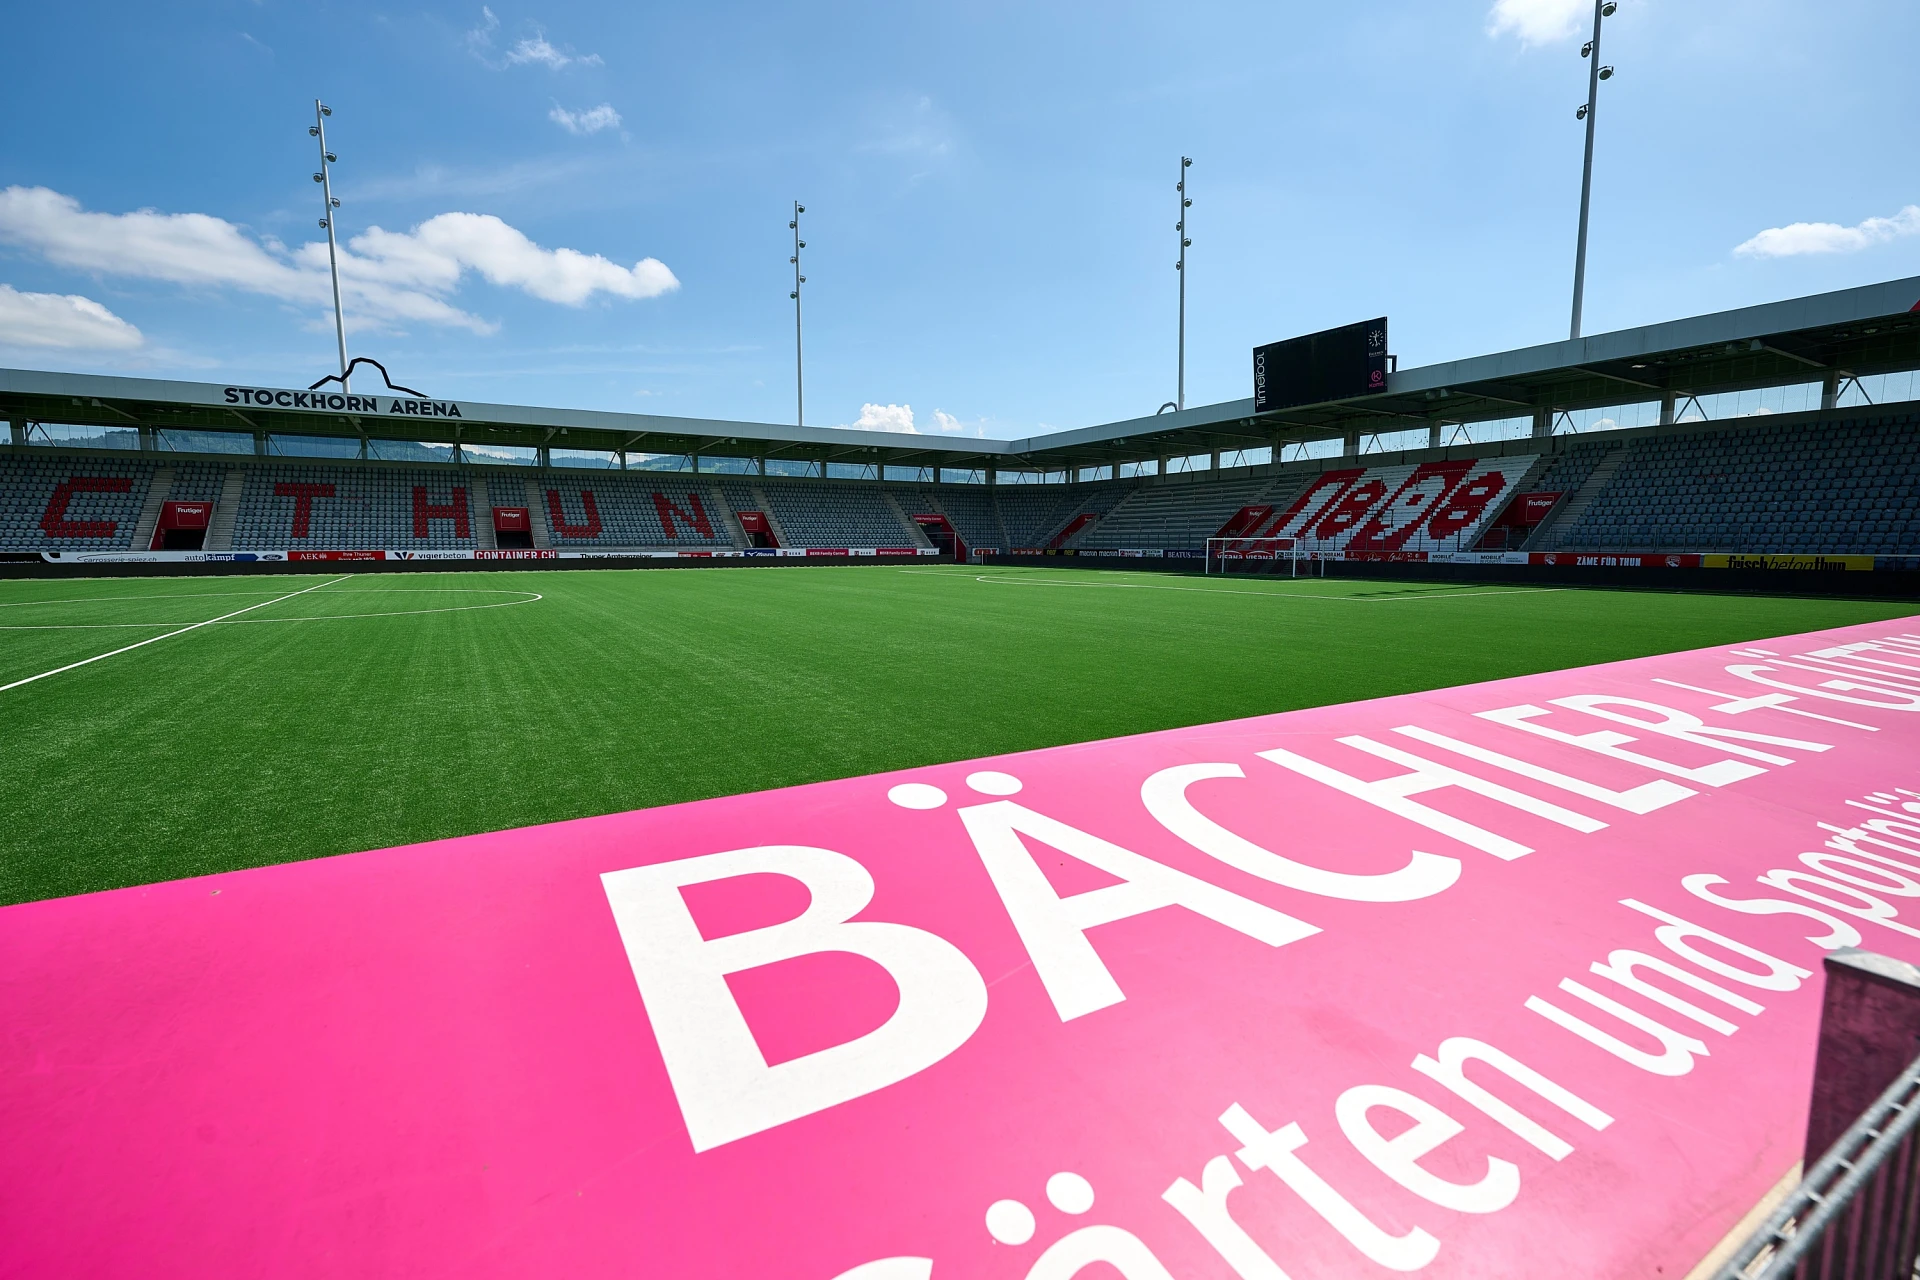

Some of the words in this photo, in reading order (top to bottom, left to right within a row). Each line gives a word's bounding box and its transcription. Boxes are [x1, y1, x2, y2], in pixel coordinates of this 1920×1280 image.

[223, 387, 378, 413] STOCKHORN
[389, 399, 463, 418] ARENA
[1577, 555, 1599, 566] ZÄME
[1601, 556, 1617, 567] FÜR
[1620, 557, 1642, 567] THUN
[600, 694, 1835, 1154] BÄCHLER
[1526, 898, 1814, 1077] und
